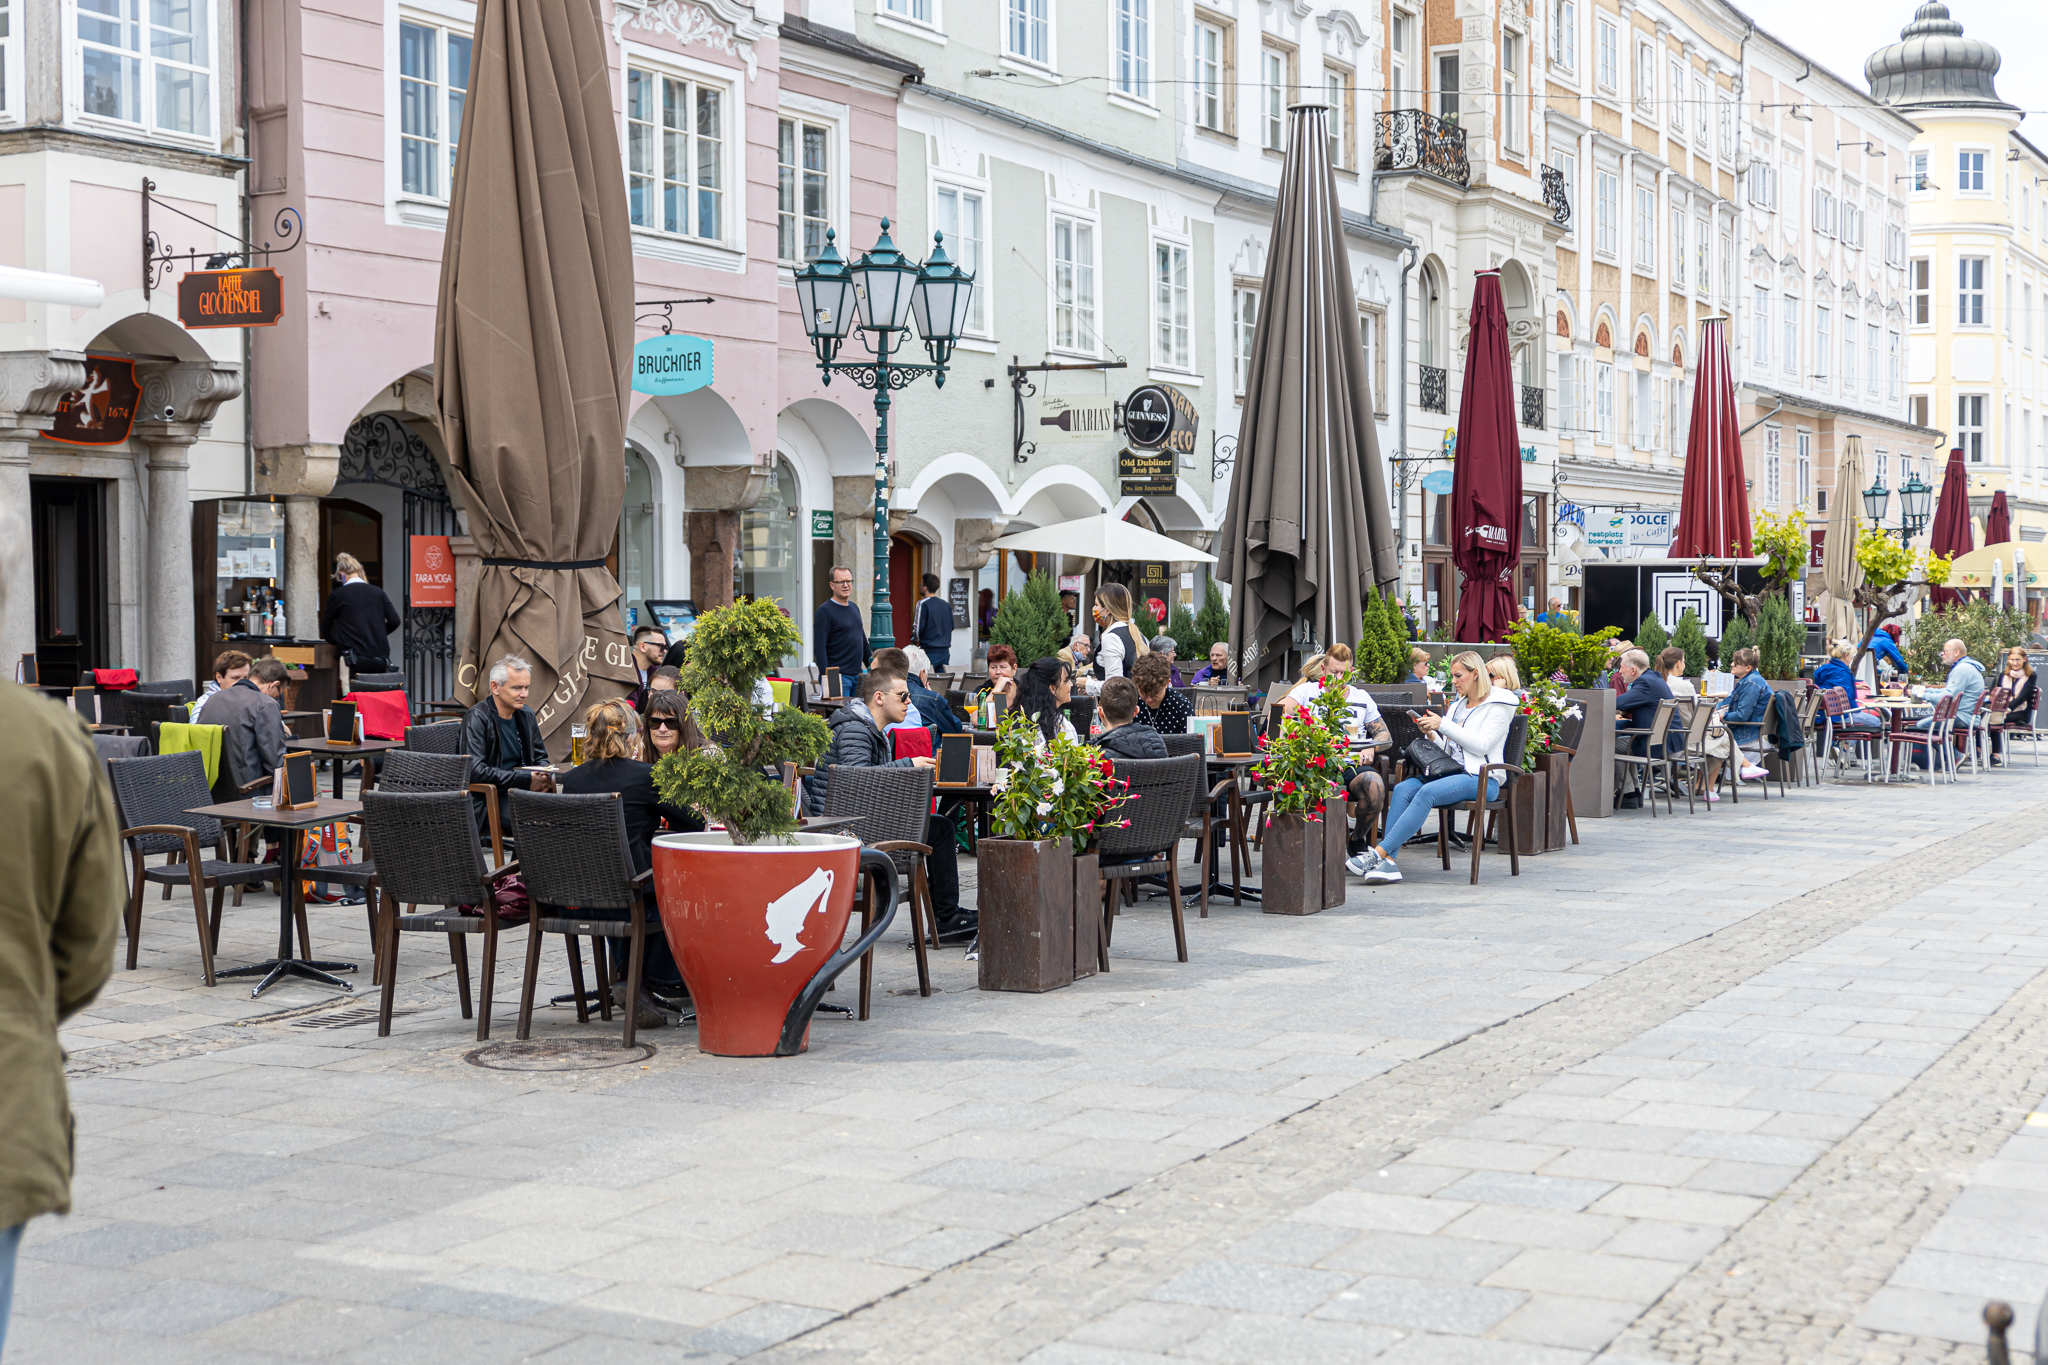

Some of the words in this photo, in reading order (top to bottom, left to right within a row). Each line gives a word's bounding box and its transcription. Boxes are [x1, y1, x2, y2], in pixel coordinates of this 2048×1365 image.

[218, 275, 242, 292] KAFFEE
[199, 290, 263, 315] GLOCKENSPIEL
[638, 351, 702, 375] BRUCKNER
[391, 382, 404, 398] 17
[57, 401, 70, 413] IT
[108, 406, 128, 418] 1674
[1128, 410, 1168, 422] GUINNESS
[1521, 446, 1538, 462] e.at
[1120, 458, 1136, 467] Old
[1137, 458, 1172, 467] Dubliner
[1131, 467, 1148, 475] Irish
[1148, 466, 1162, 475] Pub
[1559, 503, 1576, 523] AFFE
[1588, 531, 1624, 539] restplatz
[1815, 550, 1822, 559] L
[415, 573, 434, 584] TARA
[434, 573, 453, 584] YOGA
[1147, 577, 1169, 585] GRECO
[604, 641, 634, 668] GL
